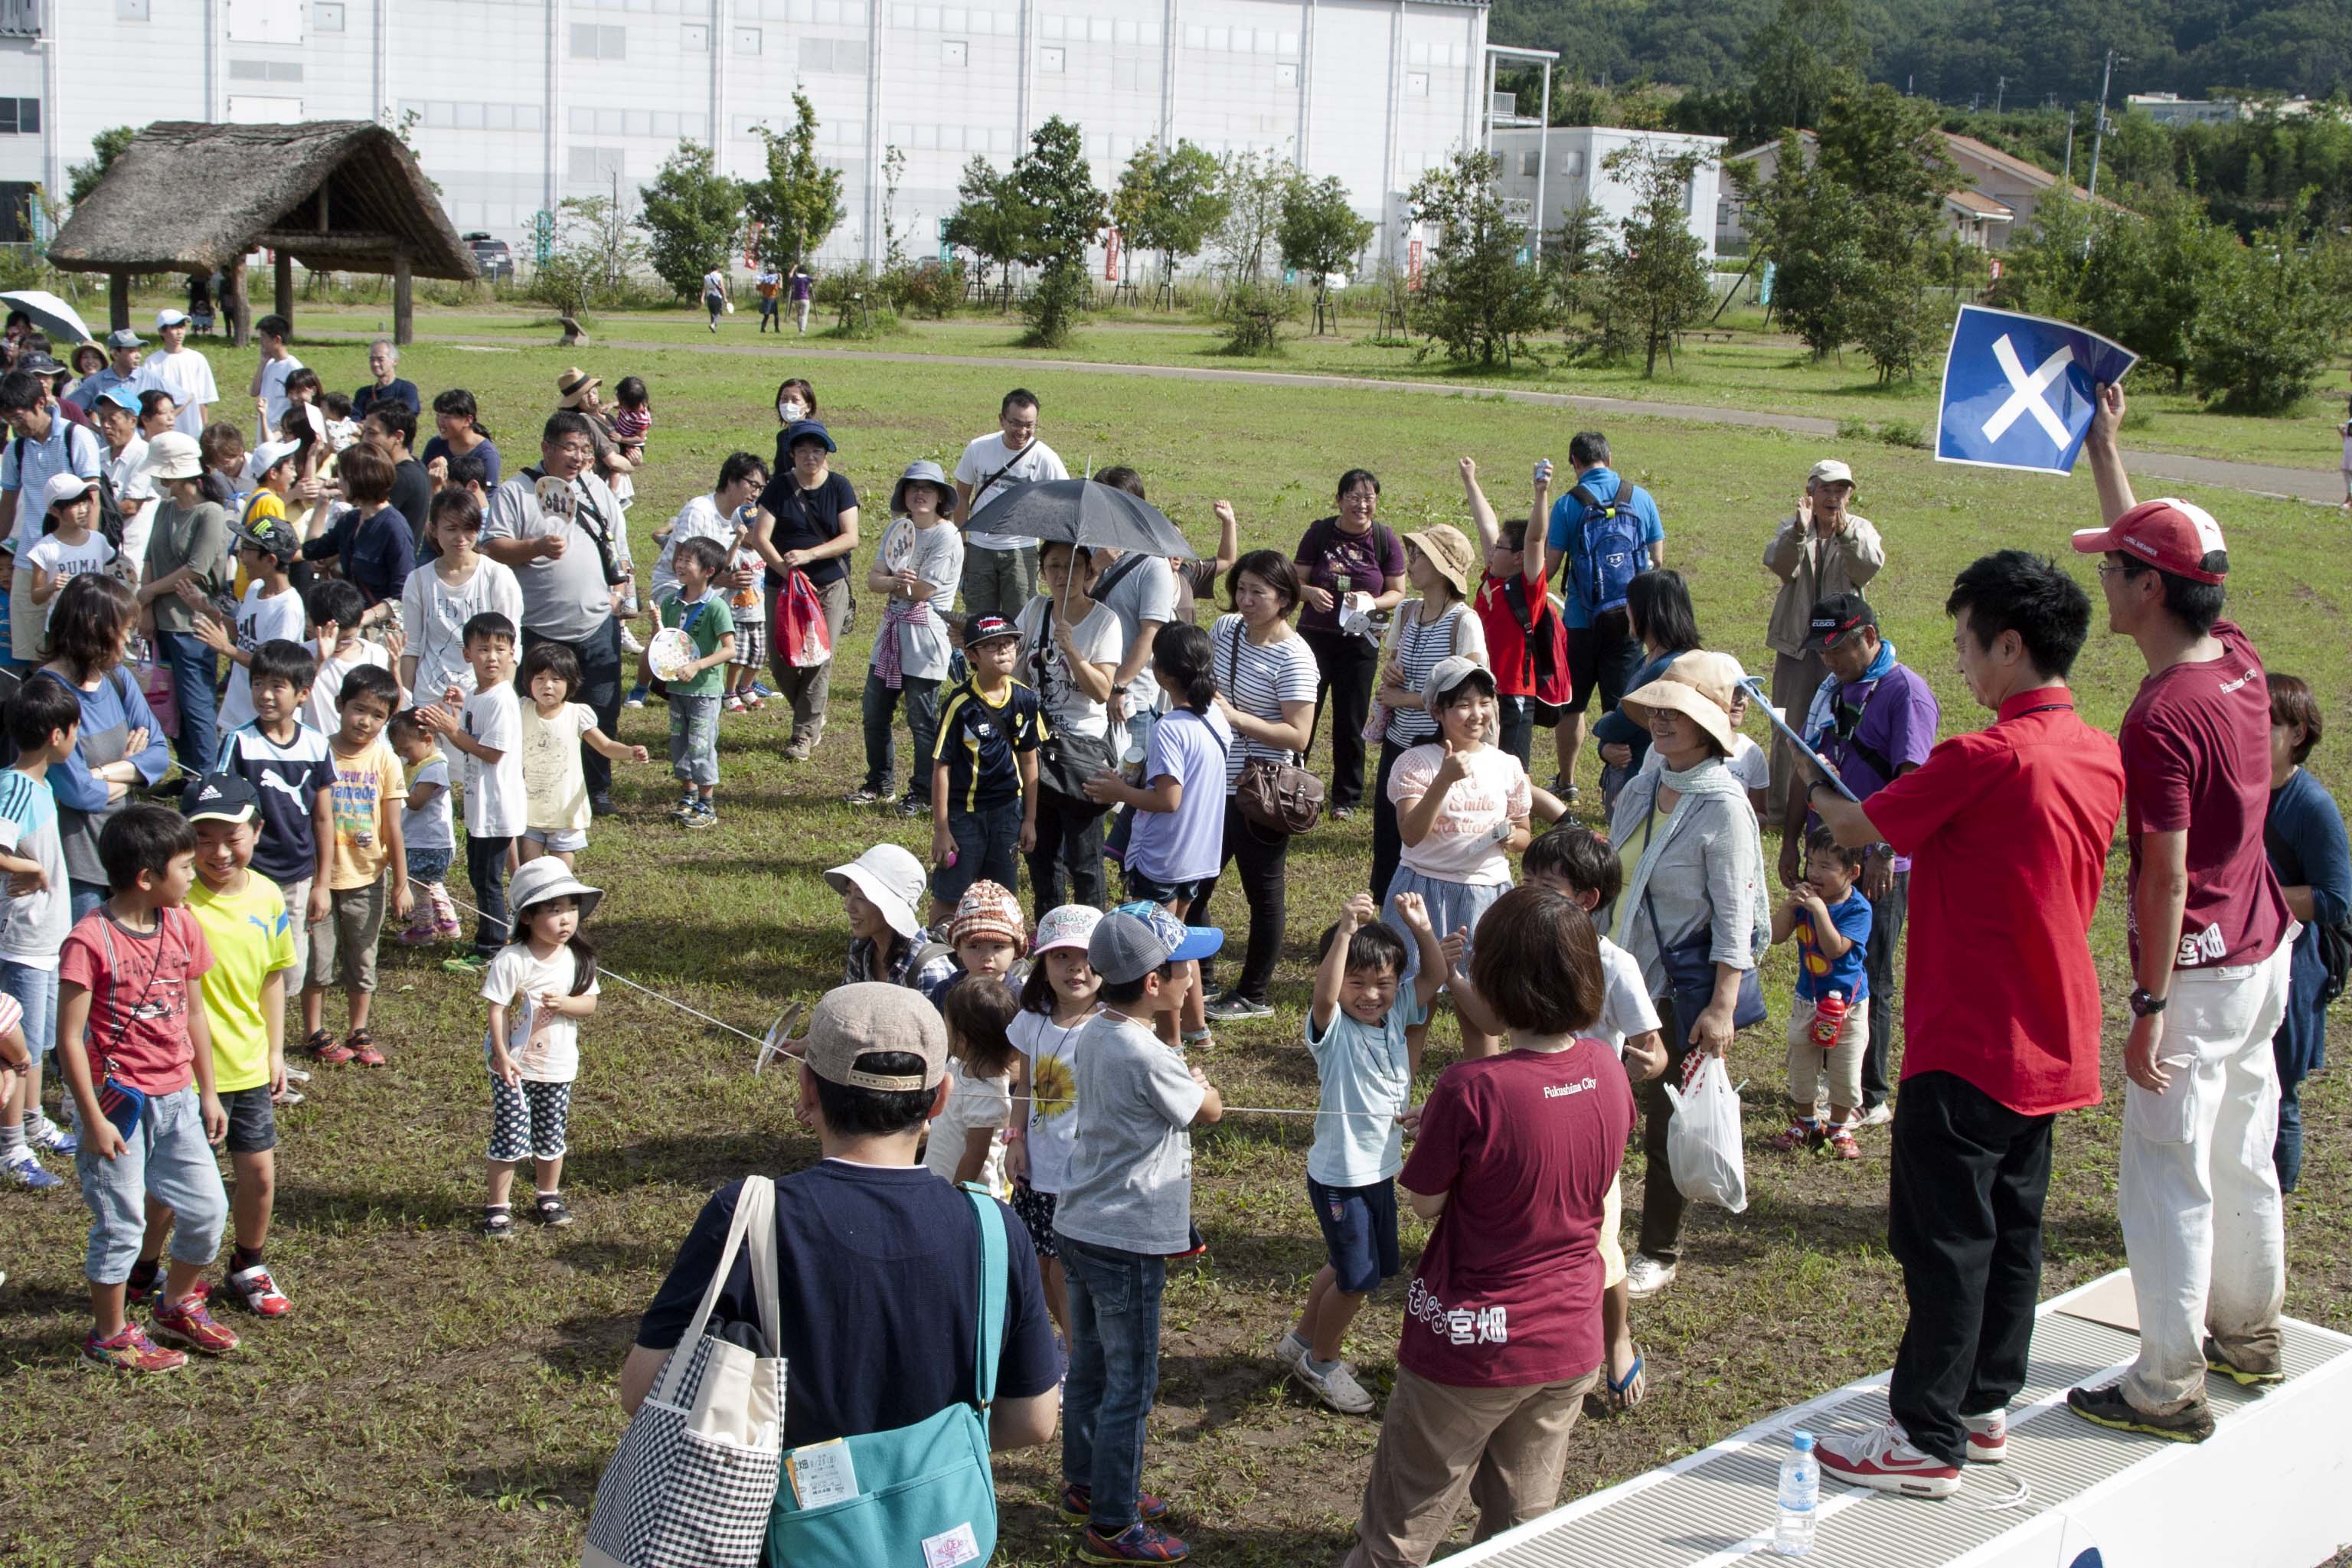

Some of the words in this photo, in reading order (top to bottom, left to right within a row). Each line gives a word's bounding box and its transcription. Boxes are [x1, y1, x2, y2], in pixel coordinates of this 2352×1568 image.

[57, 559, 97, 575] PUMA
[1449, 793, 1495, 812] Smile
[1544, 1082, 1583, 1099] Fukushima
[1582, 1077, 1597, 1090] City
